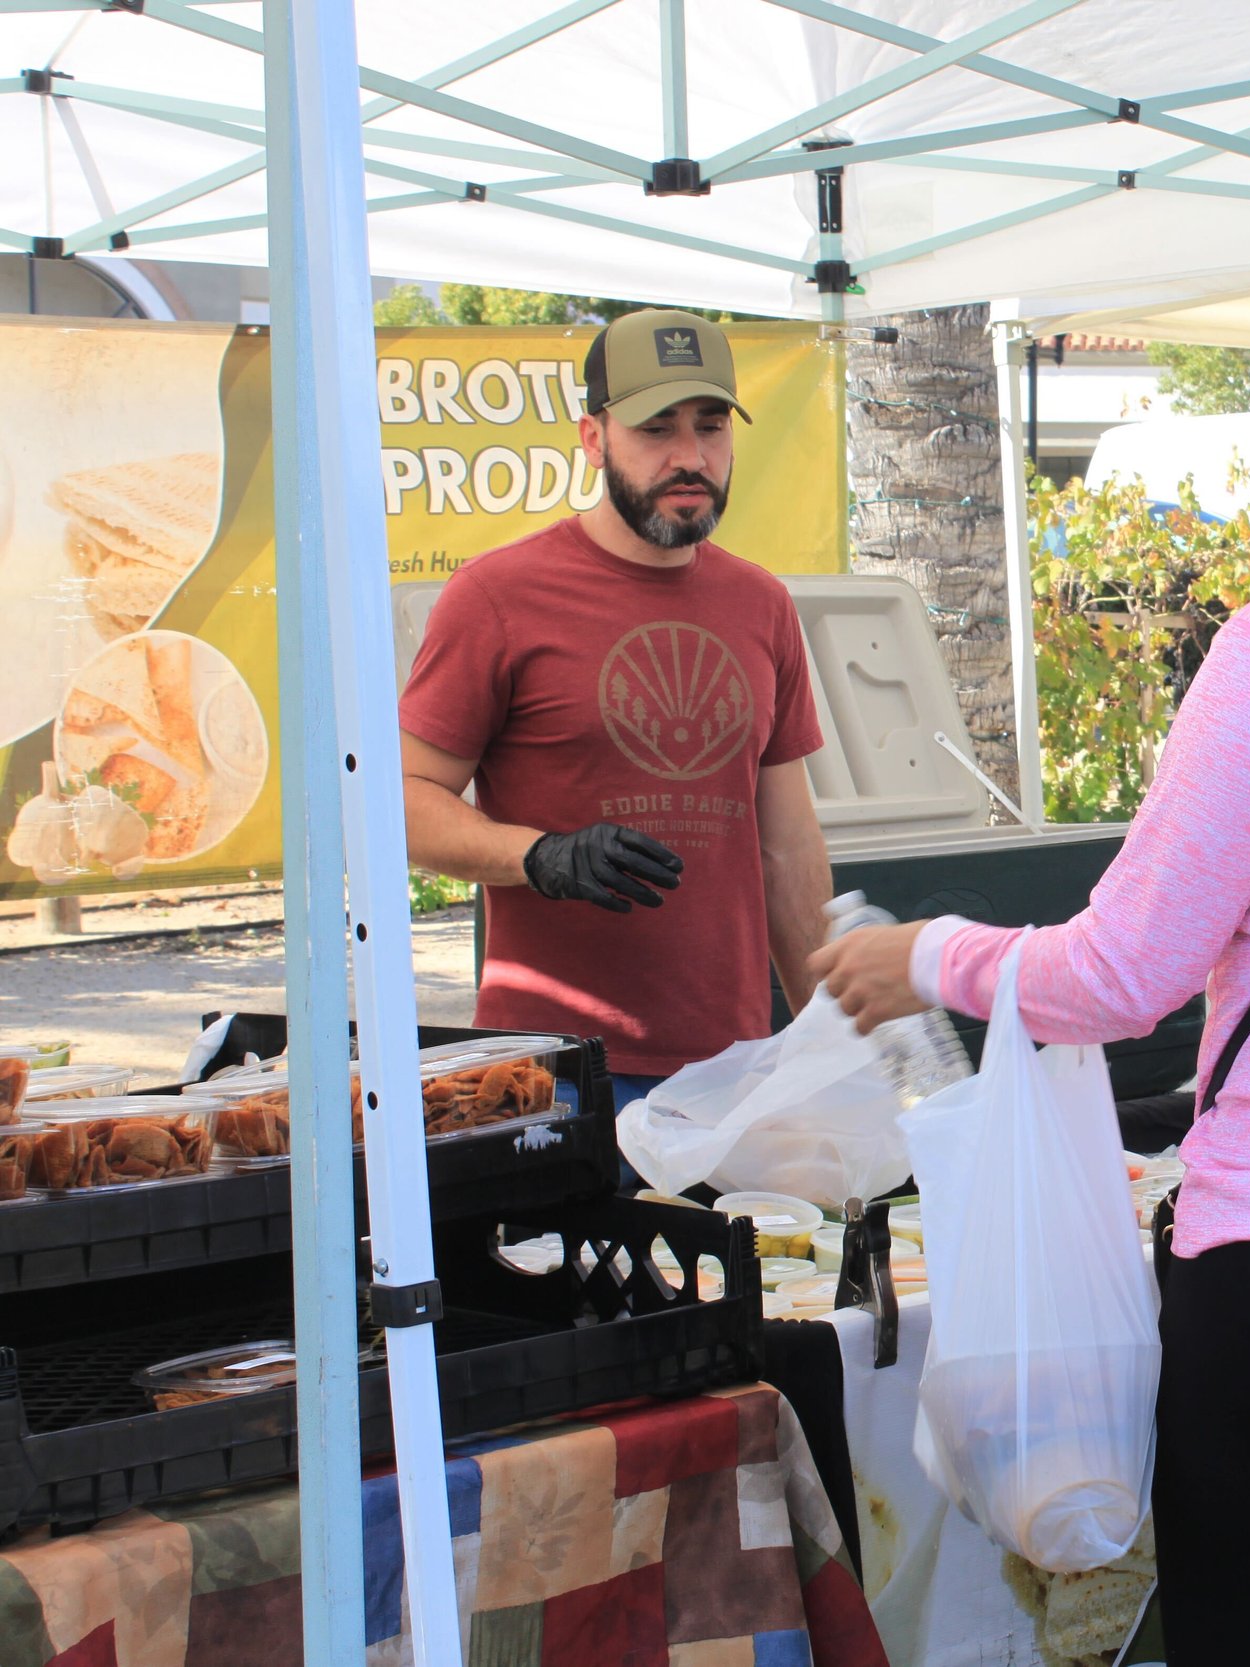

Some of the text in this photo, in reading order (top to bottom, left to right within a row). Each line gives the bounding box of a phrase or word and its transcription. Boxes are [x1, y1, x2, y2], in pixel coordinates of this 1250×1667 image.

[377, 358, 588, 424] BROTH
[380, 446, 604, 514] PRODU
[387, 551, 424, 573] esh
[602, 794, 748, 819] EDDIE BAUER
